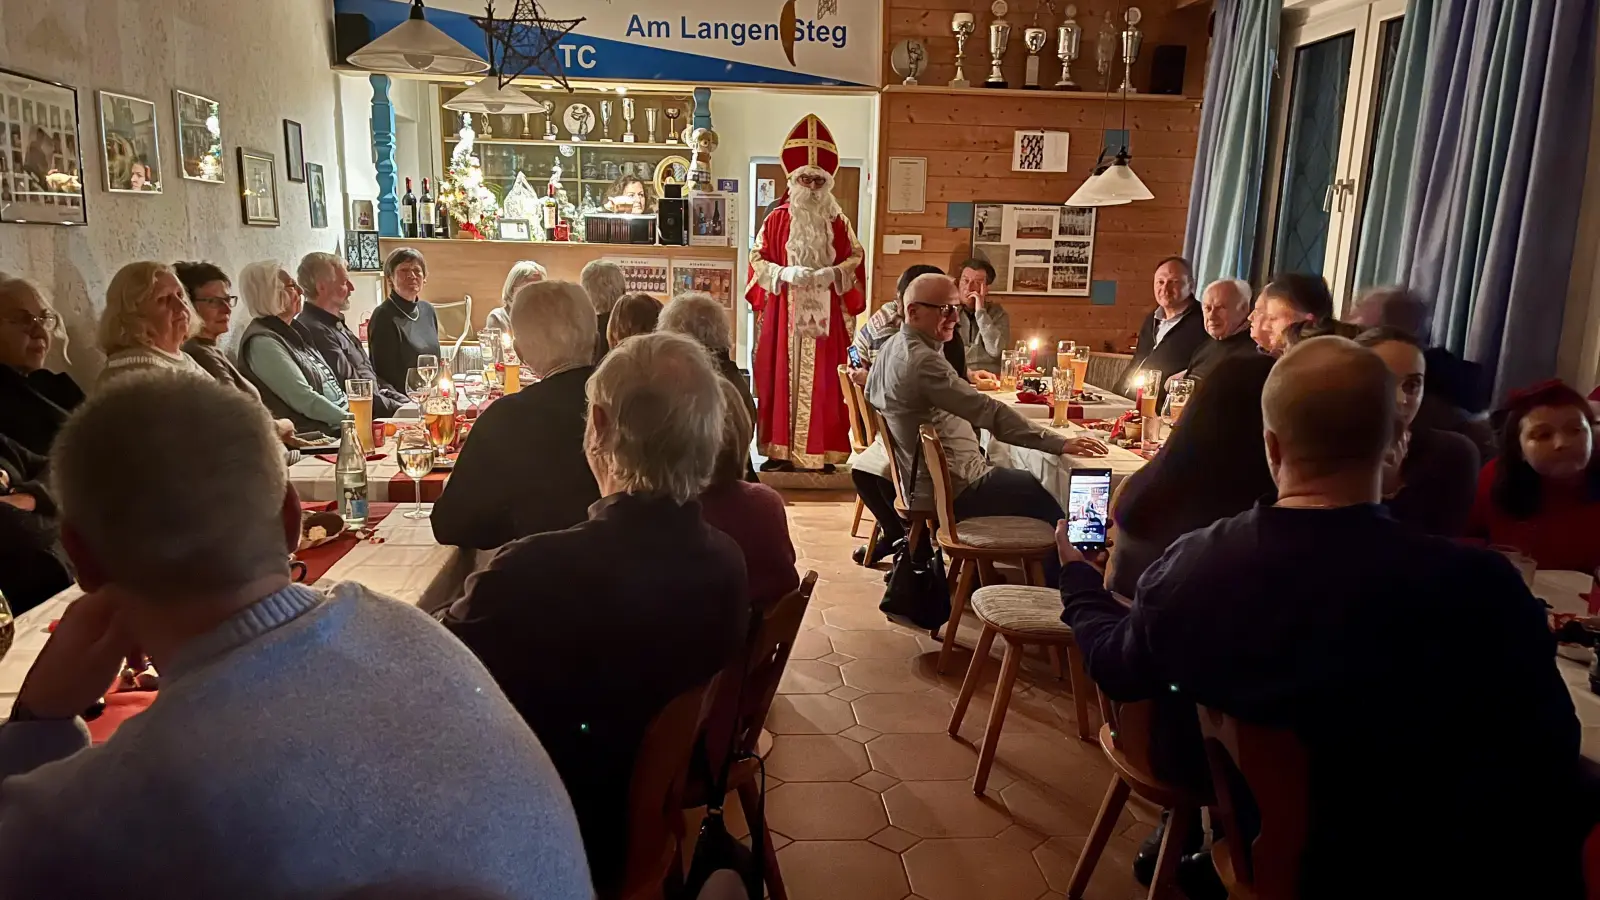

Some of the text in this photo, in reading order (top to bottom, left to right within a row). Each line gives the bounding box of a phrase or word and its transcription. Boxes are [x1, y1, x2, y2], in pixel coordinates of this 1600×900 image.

[626, 14, 847, 48] Am Langen Steg
[559, 44, 596, 69] TC
